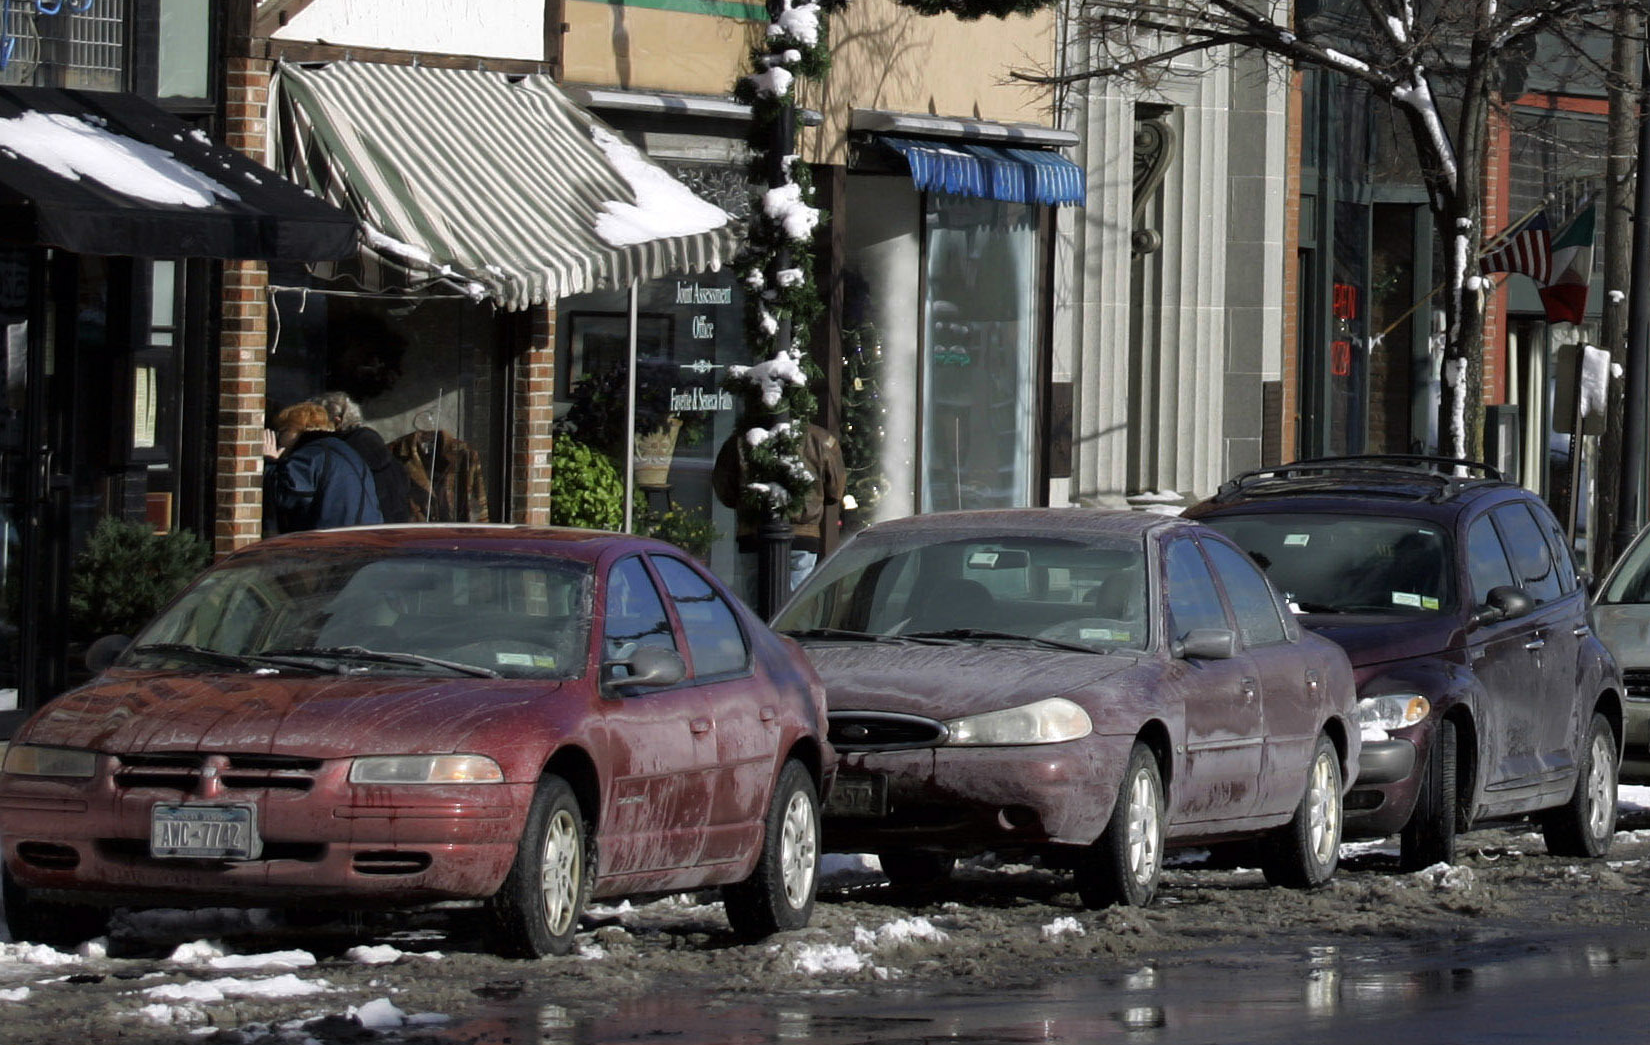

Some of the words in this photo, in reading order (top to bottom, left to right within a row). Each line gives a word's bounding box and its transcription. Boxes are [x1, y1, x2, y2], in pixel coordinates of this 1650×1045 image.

[676, 280, 692, 304] Joint
[693, 282, 731, 304] Assessment
[692, 316, 714, 339] Office
[670, 387, 691, 411] Fayette
[698, 387, 717, 411] Seneca
[719, 387, 733, 410] Falls
